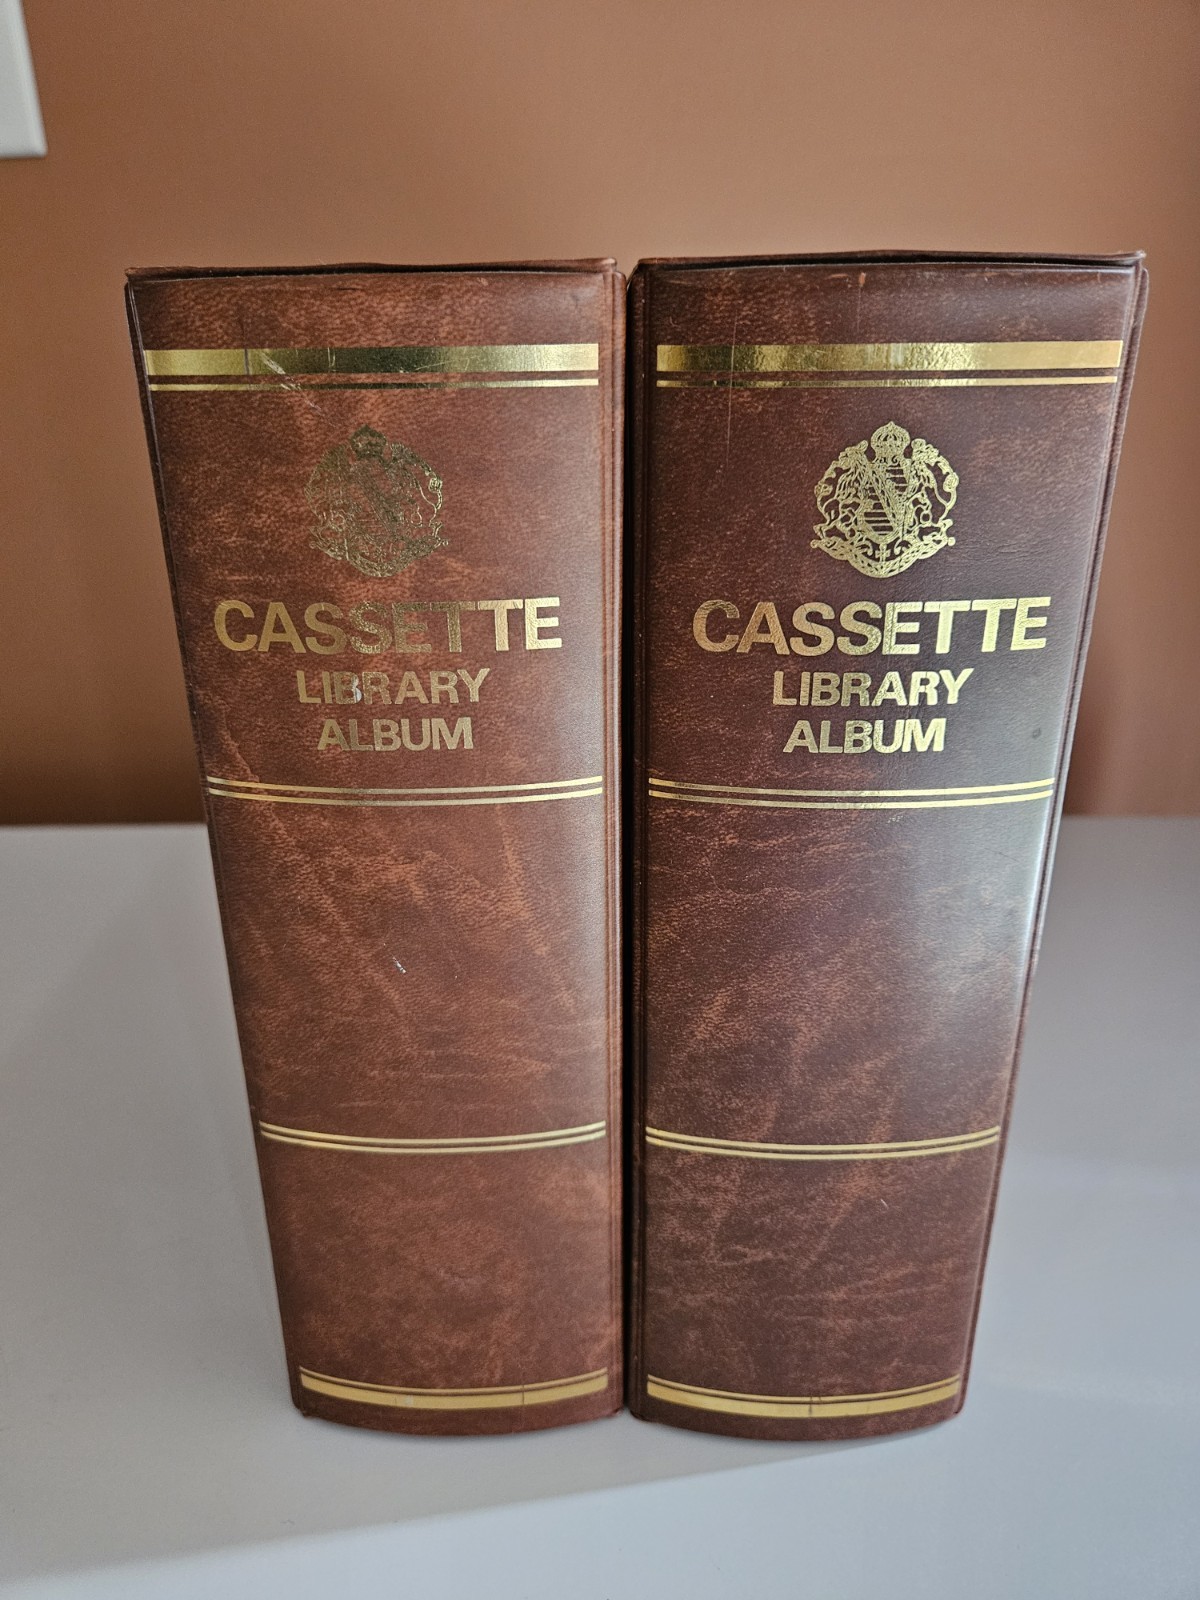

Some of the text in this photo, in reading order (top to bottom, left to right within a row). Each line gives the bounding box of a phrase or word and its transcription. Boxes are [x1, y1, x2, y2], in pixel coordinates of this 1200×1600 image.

[214, 597, 562, 654] CASSETTE
[693, 597, 1051, 656] CASSETTE
[296, 667, 490, 704] LIBRARY
[773, 667, 974, 707] LIBRARY
[317, 717, 474, 751] ALBUM
[783, 717, 947, 753] ALBUM
